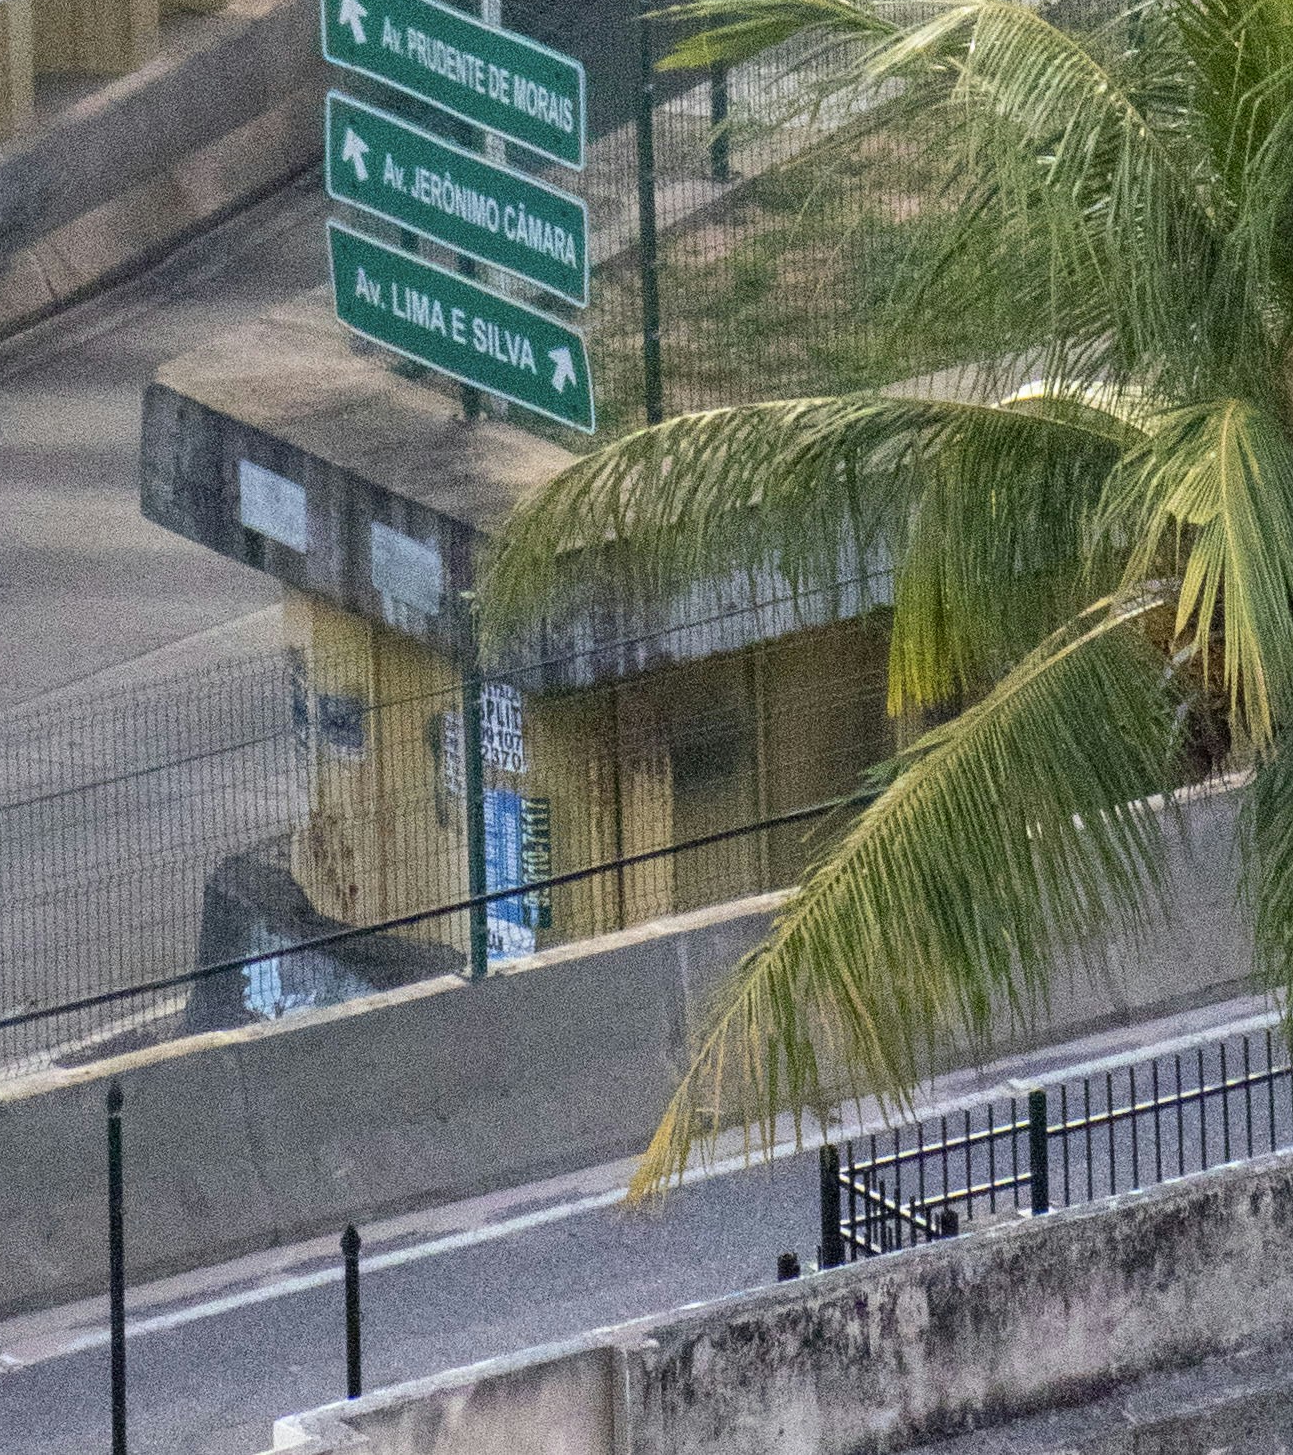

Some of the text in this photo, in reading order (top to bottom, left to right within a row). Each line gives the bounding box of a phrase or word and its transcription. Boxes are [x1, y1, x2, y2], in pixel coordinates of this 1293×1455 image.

[382, 16, 574, 134] Av. PRUDENTE DE MORAIS
[383, 152, 577, 270] Av. JERÔNIMO CÂMARA
[355, 266, 538, 375] Av. LIMA E SILVA
